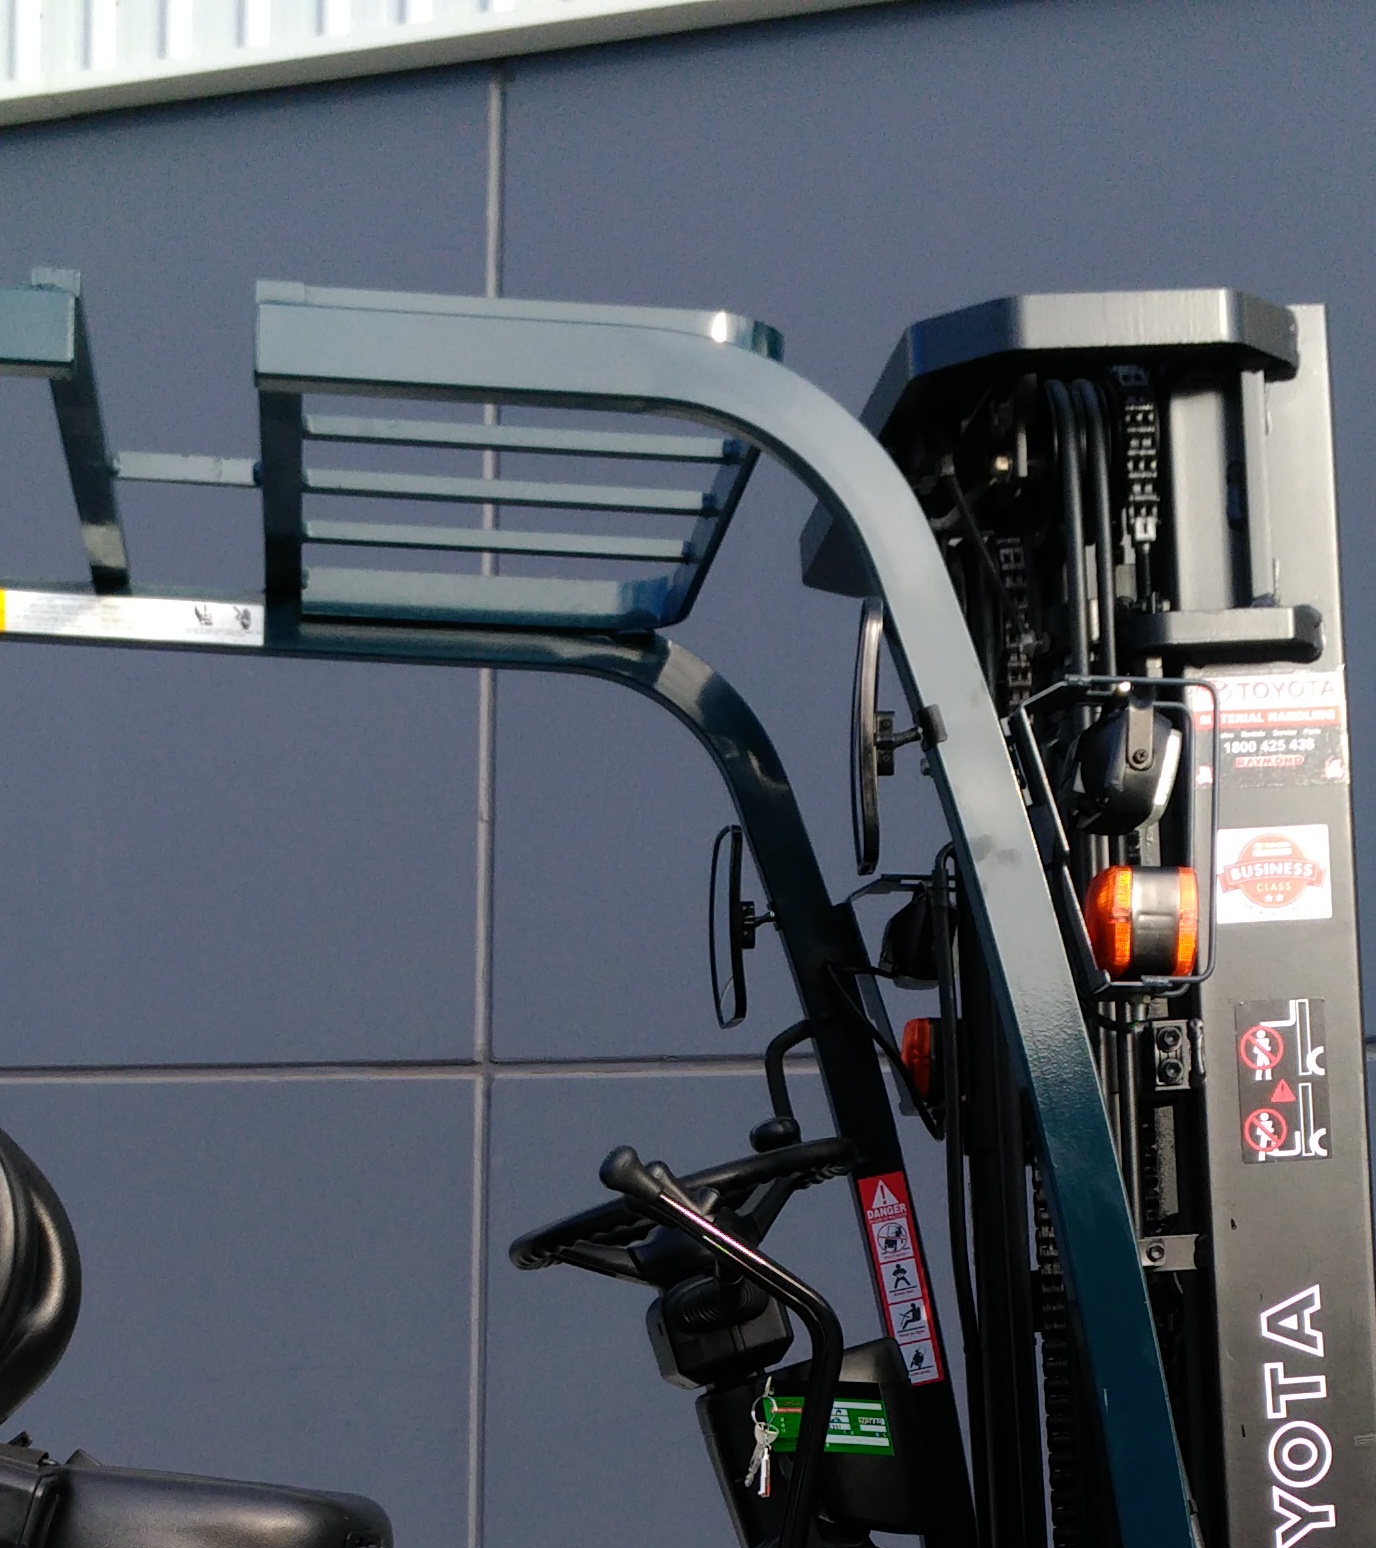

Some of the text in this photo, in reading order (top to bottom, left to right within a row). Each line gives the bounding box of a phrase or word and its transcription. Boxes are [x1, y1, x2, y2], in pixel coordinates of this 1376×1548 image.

[1237, 680, 1335, 700] TOYOTA
[1199, 712, 1265, 726] MTERIAL
[1223, 740, 1257, 754] 1800
[1260, 738, 1287, 753] 425
[1236, 755, 1304, 768] RAYMOND
[1229, 861, 1314, 882] BUSINESS
[1255, 881, 1293, 893] CLASS
[866, 1203, 907, 1220] DANGER
